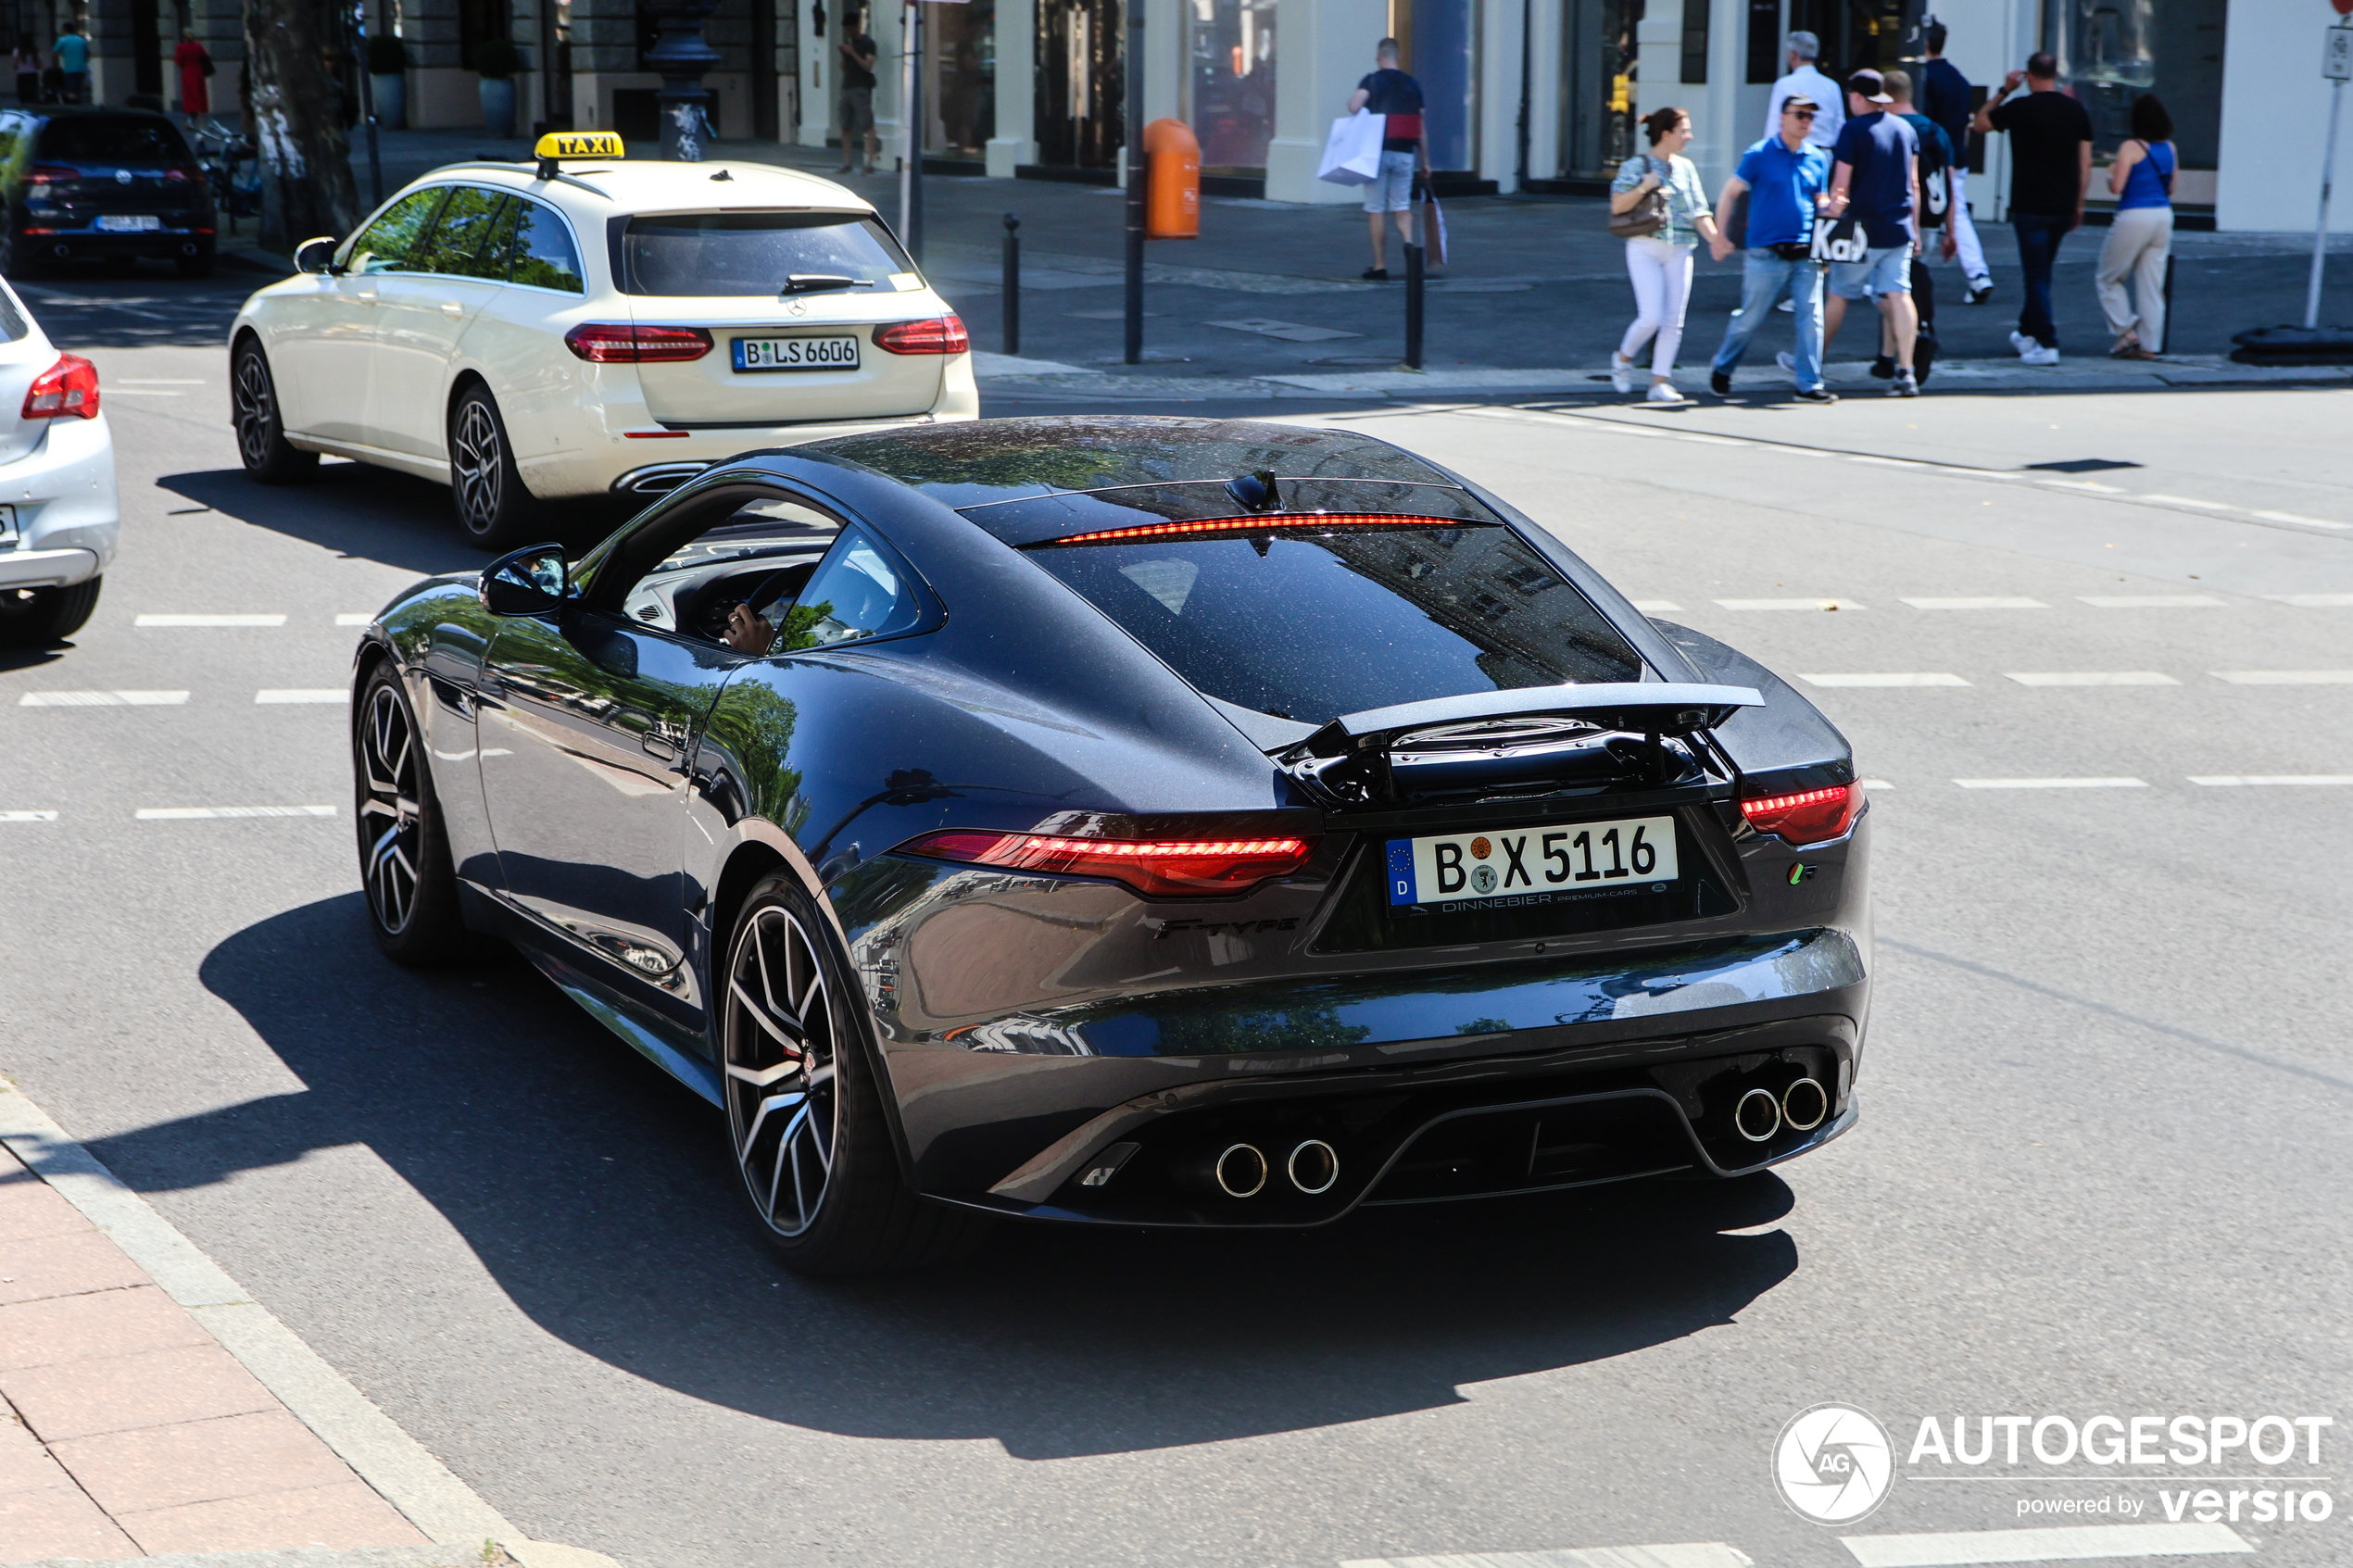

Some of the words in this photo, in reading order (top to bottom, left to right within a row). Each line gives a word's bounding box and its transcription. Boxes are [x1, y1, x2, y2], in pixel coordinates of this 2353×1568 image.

[560, 137, 612, 154] TAXI
[747, 343, 760, 364] B
[774, 342, 800, 363] LS
[806, 341, 854, 362] 6606
[1435, 843, 1466, 894] B
[1501, 836, 1532, 888] X
[1541, 825, 1656, 884] 5116
[1397, 880, 1408, 896] D
[1441, 894, 1552, 913] DINNEBIER
[1557, 889, 1638, 902] PREMIUM-CARS
